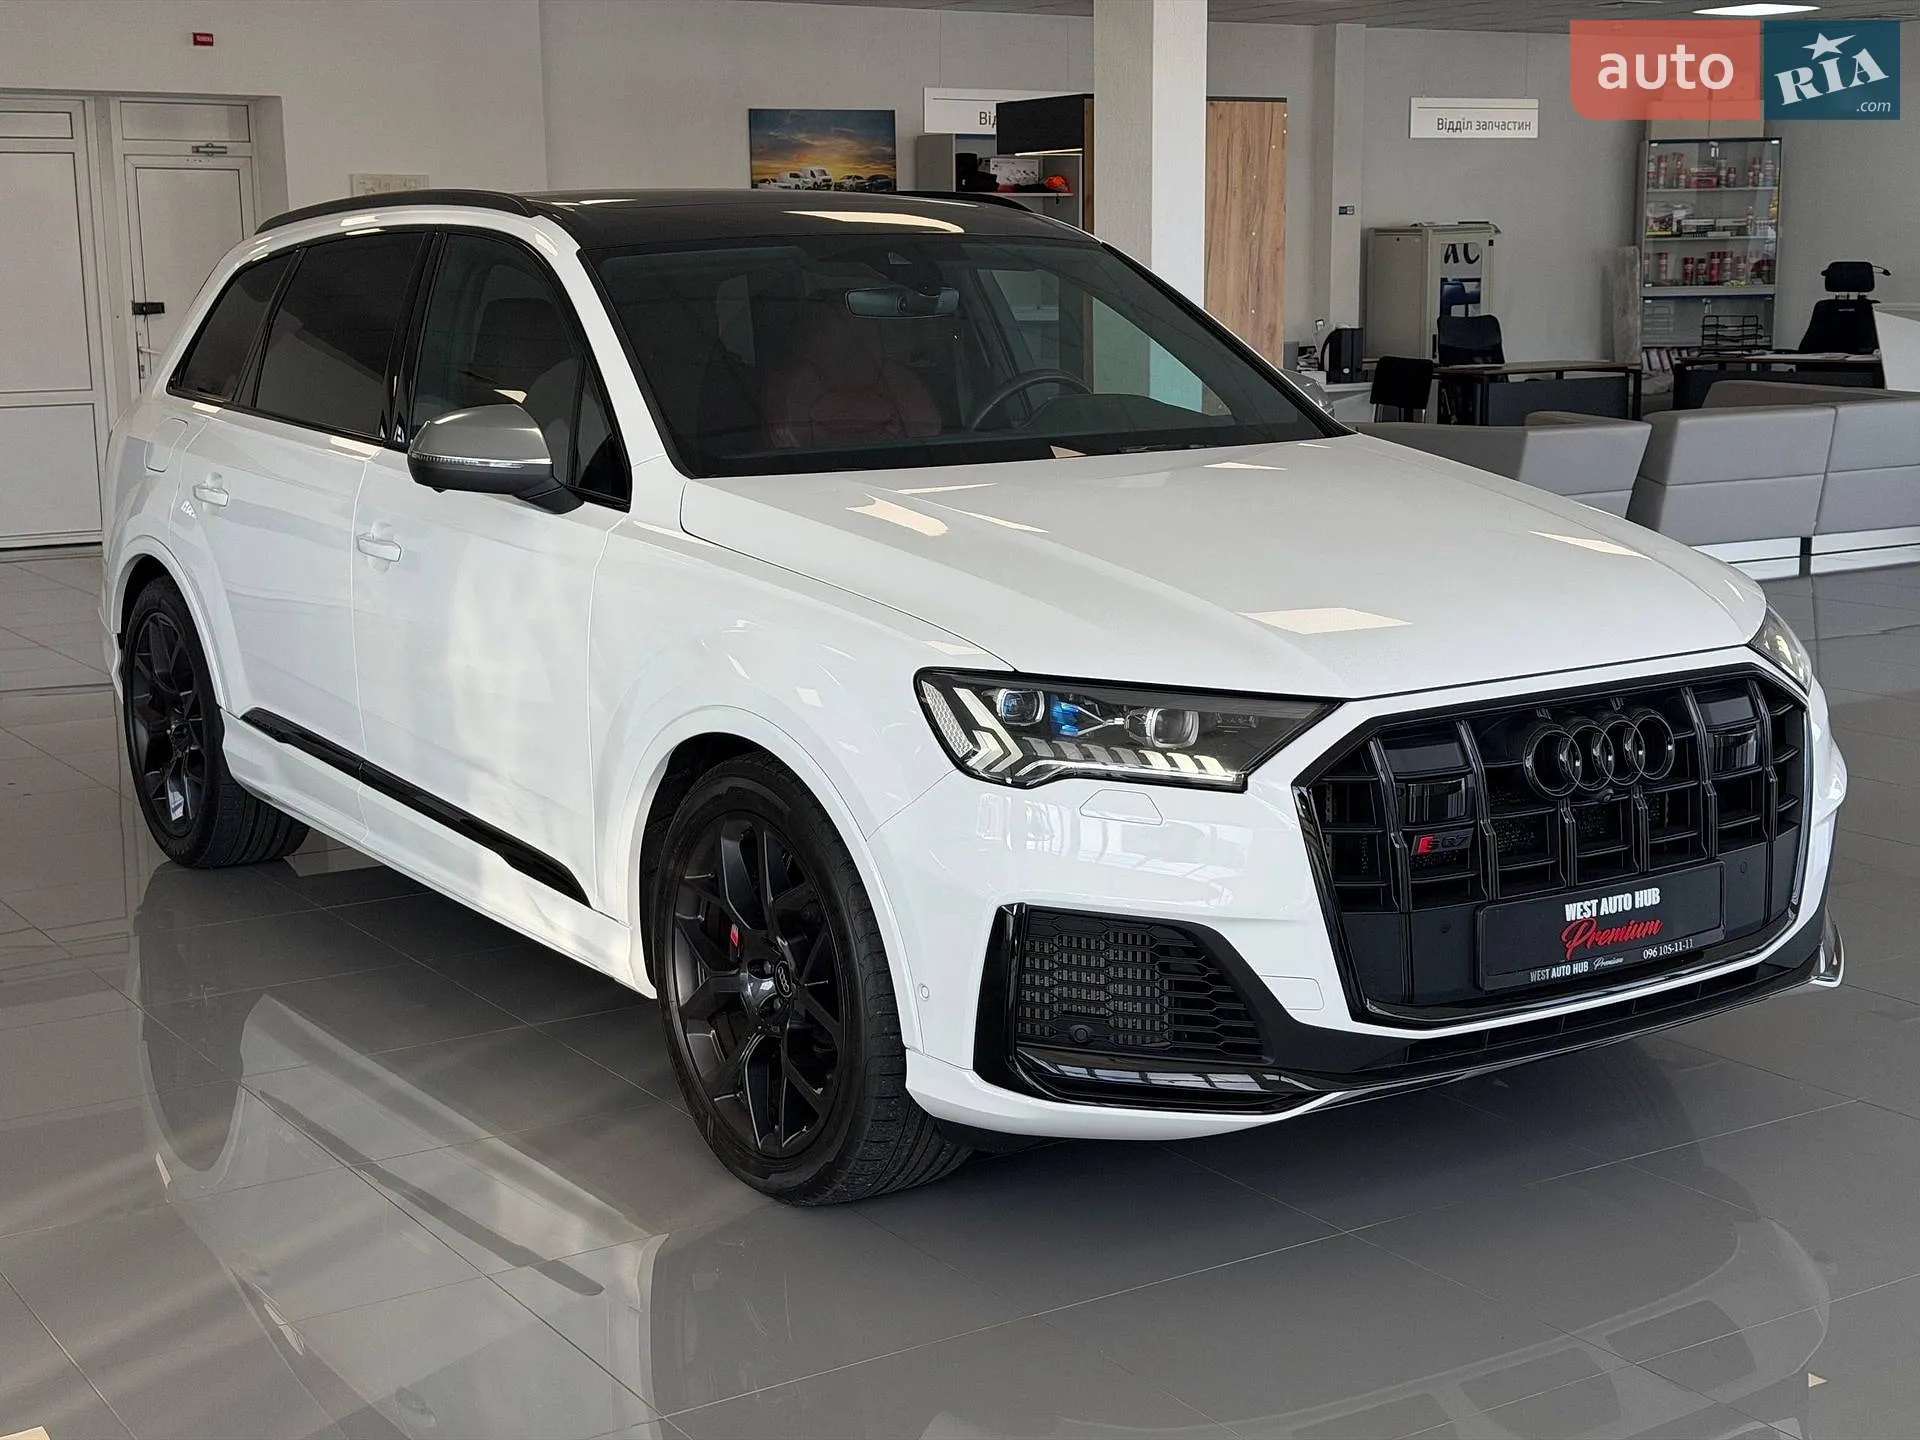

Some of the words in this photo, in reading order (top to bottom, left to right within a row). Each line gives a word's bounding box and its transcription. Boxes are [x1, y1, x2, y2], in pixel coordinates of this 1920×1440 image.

[1437, 117, 1472, 133] Відділ
[1475, 120, 1531, 131] запчастин
[1565, 899, 1598, 921] WEST
[1600, 893, 1632, 916] AUTO
[1634, 887, 1660, 909] HUB
[1560, 918, 1664, 961] Premium
[1643, 947, 1657, 960] 096
[1658, 938, 1693, 957] 105-11-11
[1530, 969, 1550, 982] WEST
[1550, 964, 1570, 979] AUTO
[1572, 961, 1589, 975] HUB
[1593, 956, 1623, 970] Premium
